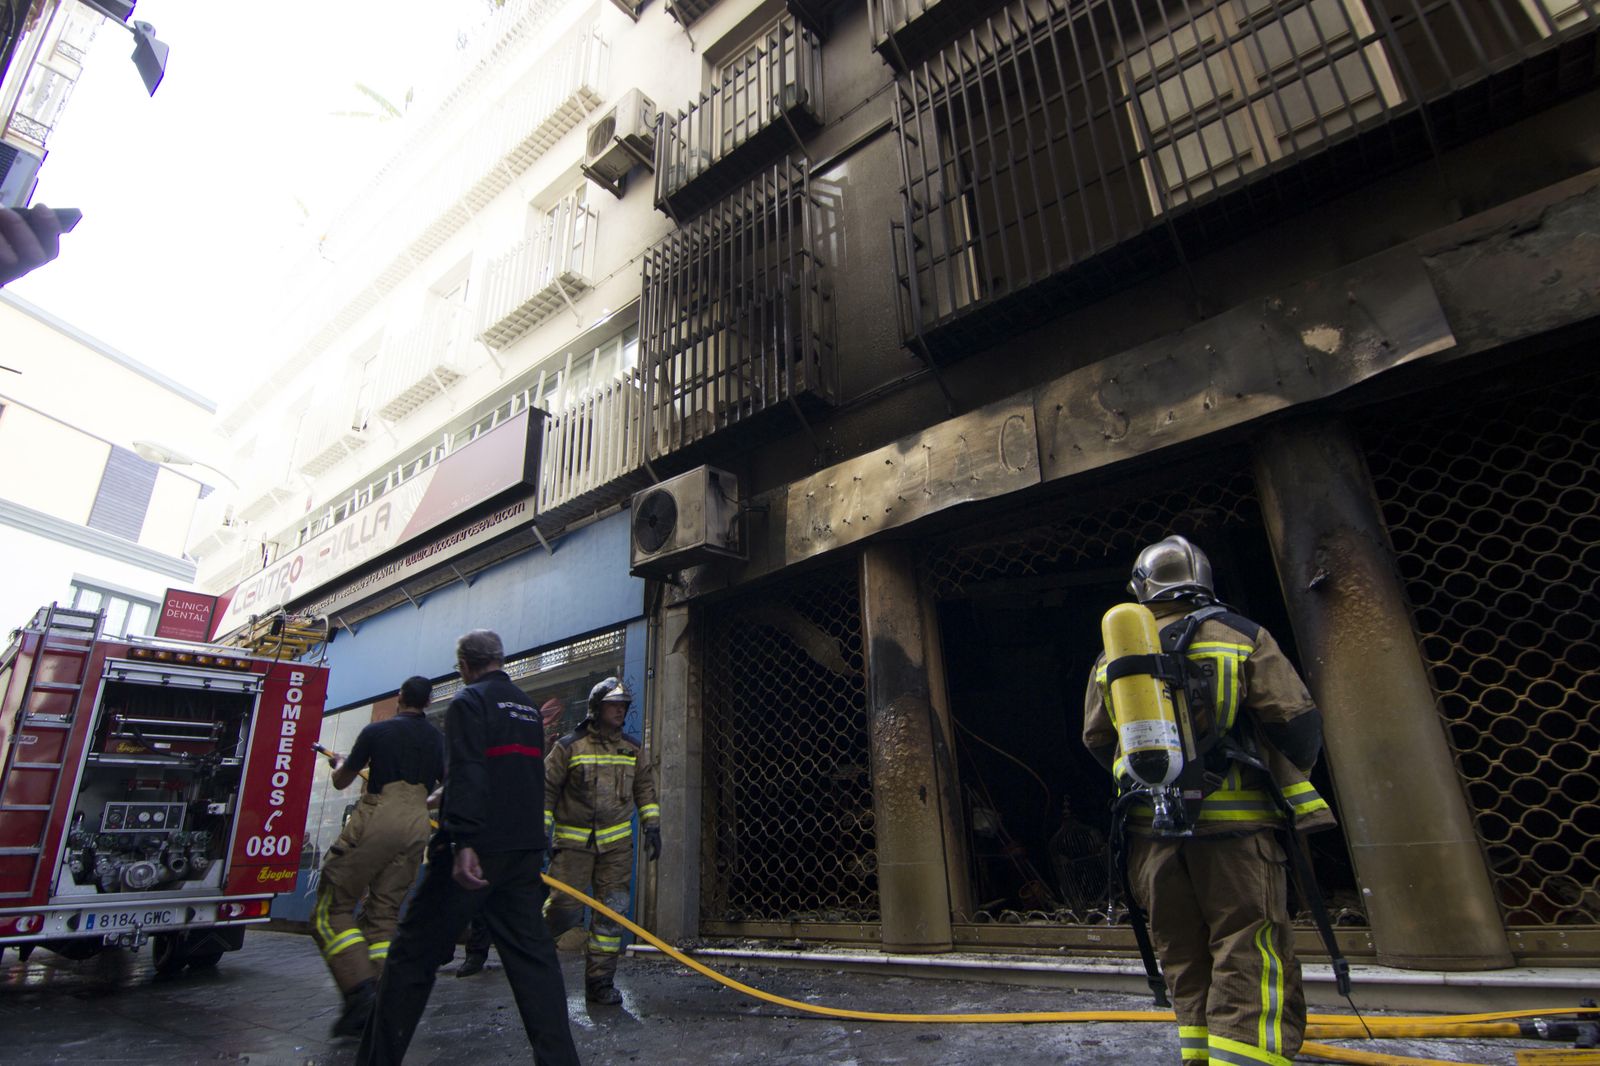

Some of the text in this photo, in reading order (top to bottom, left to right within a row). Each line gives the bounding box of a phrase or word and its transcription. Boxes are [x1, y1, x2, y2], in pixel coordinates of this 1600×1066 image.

[232, 555, 304, 615] CENTRO
[166, 608, 205, 622] DENTAL
[167, 599, 210, 613] CLINICA
[269, 671, 305, 806] BOMBEROS
[246, 835, 291, 857] 080
[257, 866, 297, 883] Ziegler
[100, 910, 172, 928] 8184 GWC
